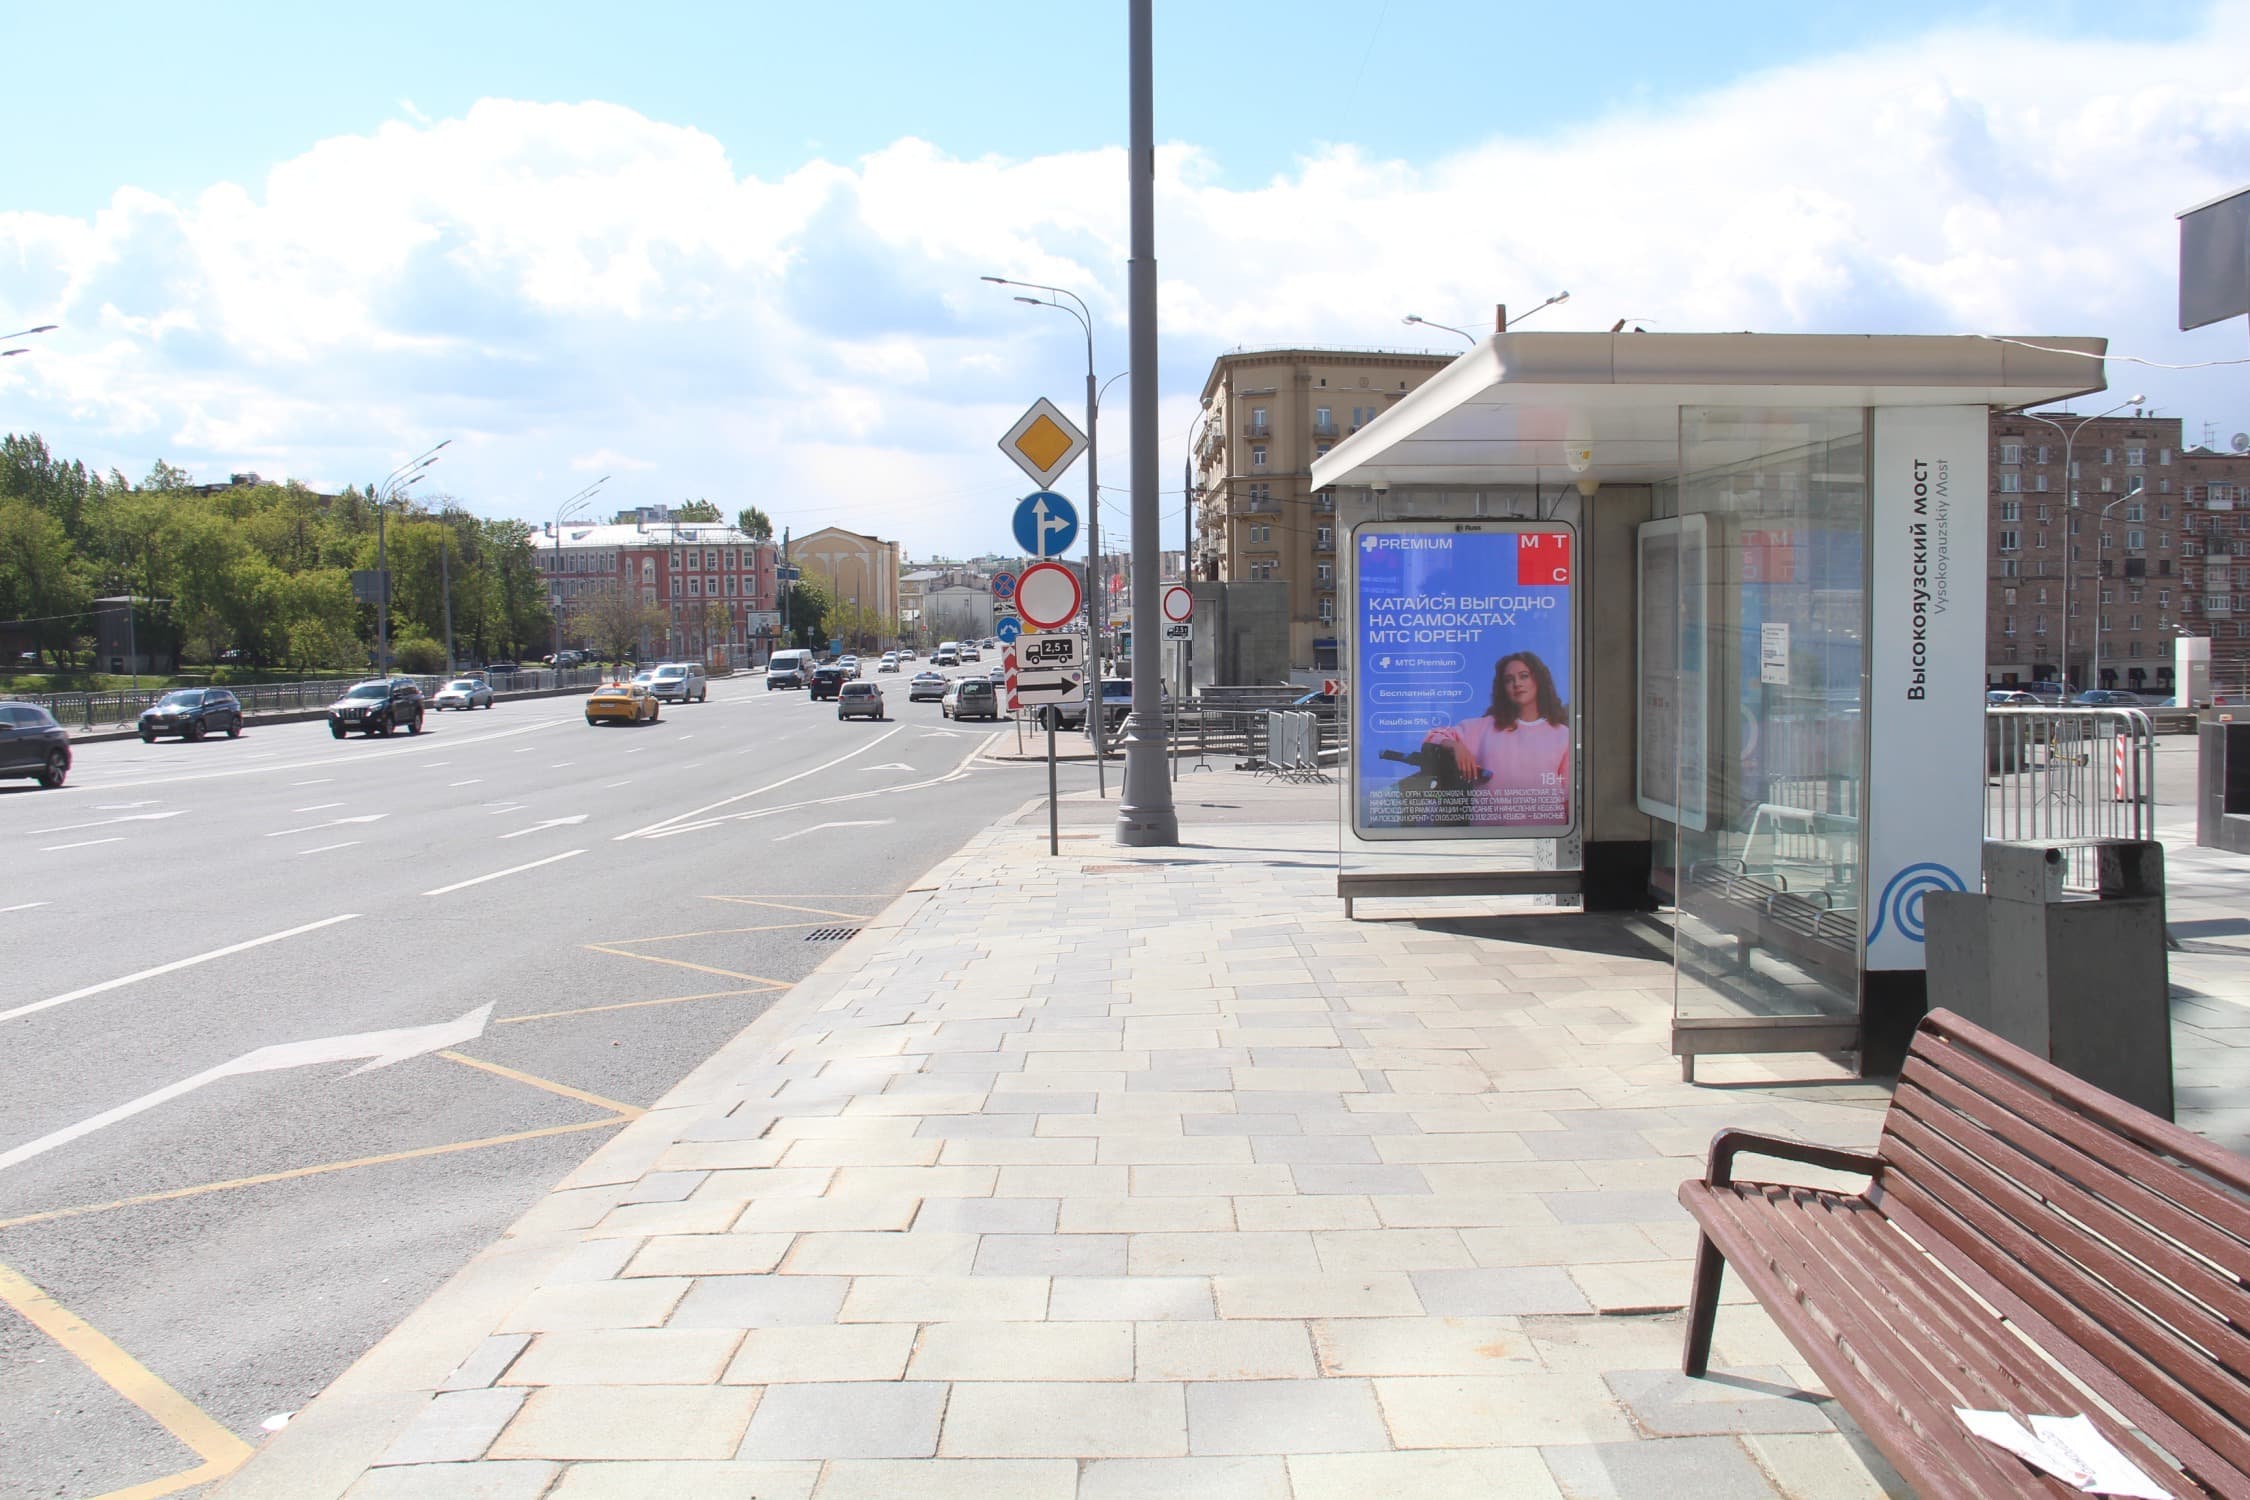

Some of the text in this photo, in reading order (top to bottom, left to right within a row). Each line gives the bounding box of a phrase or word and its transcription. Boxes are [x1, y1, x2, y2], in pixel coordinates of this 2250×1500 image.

[1934, 459, 1950, 615] Vysokoyauzskiy Most
[1379, 538, 1453, 549] PREMIUM
[1908, 459, 1931, 701] Высокояузский мост
[1369, 594, 1555, 612] КАТАЙСЯ ВЫГОДНО
[1369, 613, 1516, 626] НА САМОКАТАХ
[1369, 629, 1482, 643] МТС ЮРЕНТ
[1045, 642, 1061, 653] 2,5
[1417, 658, 1456, 666] Premium
[1379, 689, 1463, 698] Бесплатный старт
[1540, 773, 1566, 785] 18+
